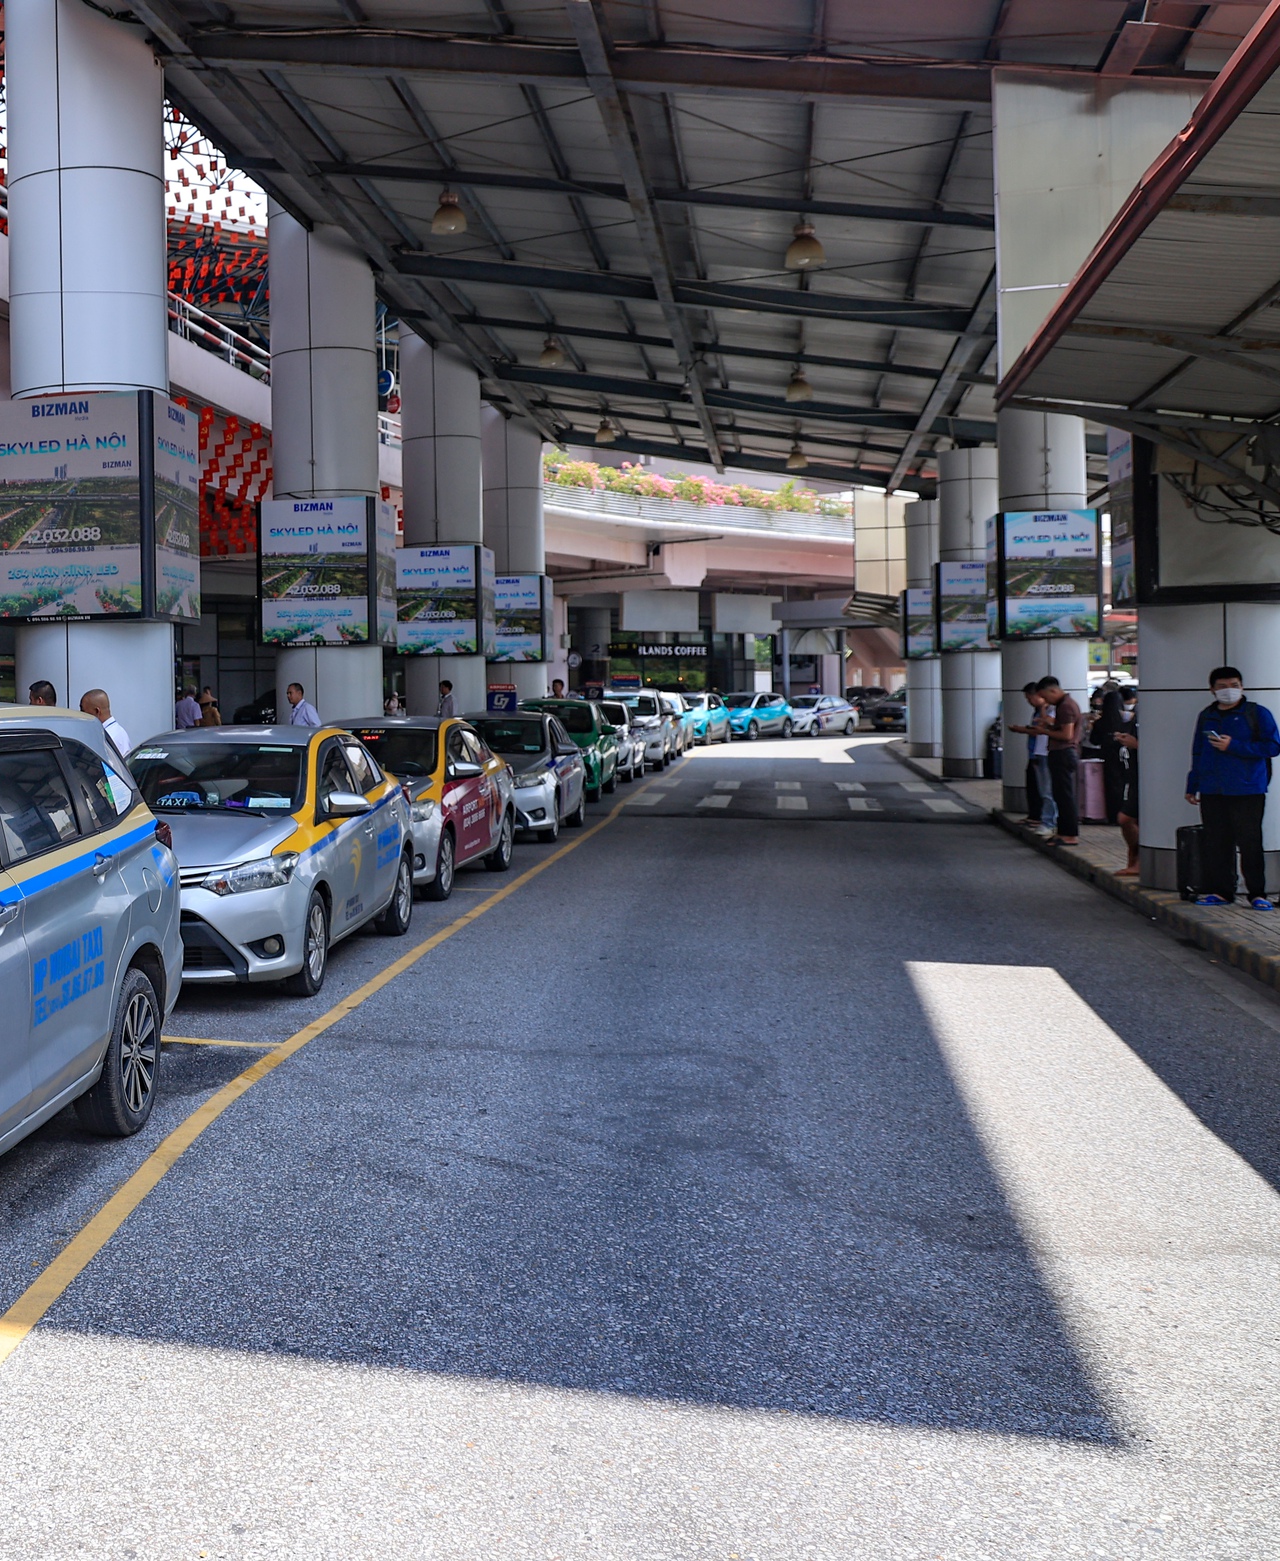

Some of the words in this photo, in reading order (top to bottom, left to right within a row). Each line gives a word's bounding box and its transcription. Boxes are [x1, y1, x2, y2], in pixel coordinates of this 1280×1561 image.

[31, 400, 89, 418] BIZMAN
[66, 434, 91, 452] HÀ
[95, 431, 127, 453] NỘI
[102, 460, 132, 469] BIZMAN
[293, 502, 333, 512] BIZMAN
[270, 526, 314, 537] SKYLED
[317, 523, 334, 535] HÀ
[337, 522, 359, 535] NỘI
[23, 526, 101, 545] 42.032.088
[420, 550, 450, 558] BIZMAN
[591, 643, 600, 653] 2
[673, 645, 708, 656] COFFEE
[160, 797, 189, 807] TAXI
[81, 926, 103, 965] TAXI
